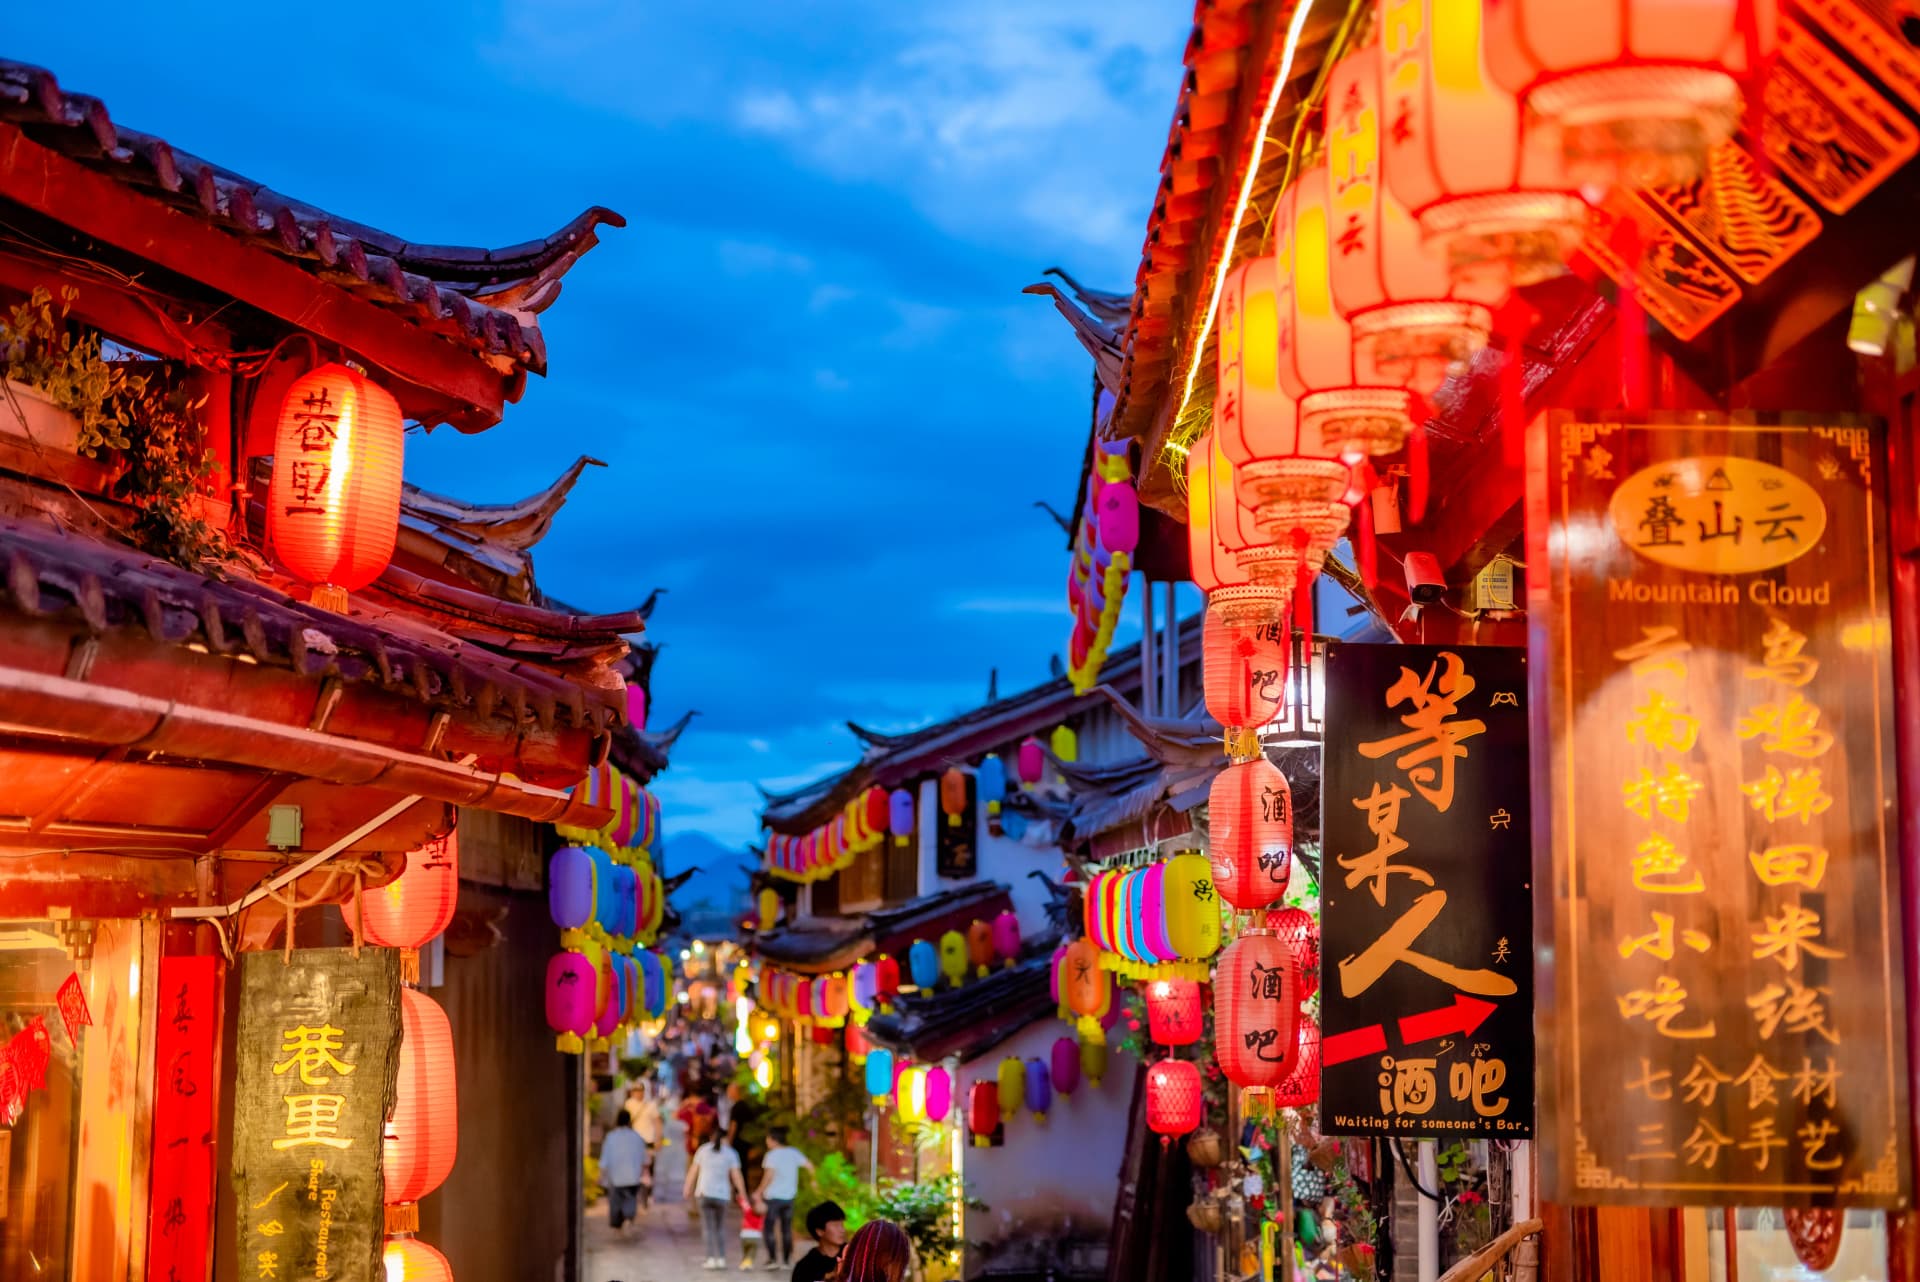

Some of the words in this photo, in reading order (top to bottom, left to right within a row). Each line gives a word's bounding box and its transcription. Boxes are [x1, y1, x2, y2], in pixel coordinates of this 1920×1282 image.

[1638, 495, 1806, 548] 叠山云
[1609, 579, 1740, 604] Mountain
[1749, 579, 1830, 606] Cloud
[1256, 785, 1290, 884] 酒吧
[1337, 651, 1518, 999] 等某人
[1613, 624, 1716, 1040] 云南特色小吃
[1244, 961, 1284, 1063] 酒吧
[272, 1022, 357, 1150] 巷里
[1378, 1055, 1510, 1118] 酒吧
[1624, 1053, 1844, 1109] 七分食材
[1334, 1115, 1389, 1130] Waiting
[1395, 1117, 1416, 1129] for
[1421, 1117, 1491, 1130] someone's
[1628, 1117, 1845, 1172] 三分手艺
[308, 1158, 324, 1201] Share
[315, 1188, 338, 1279] Restaurant
